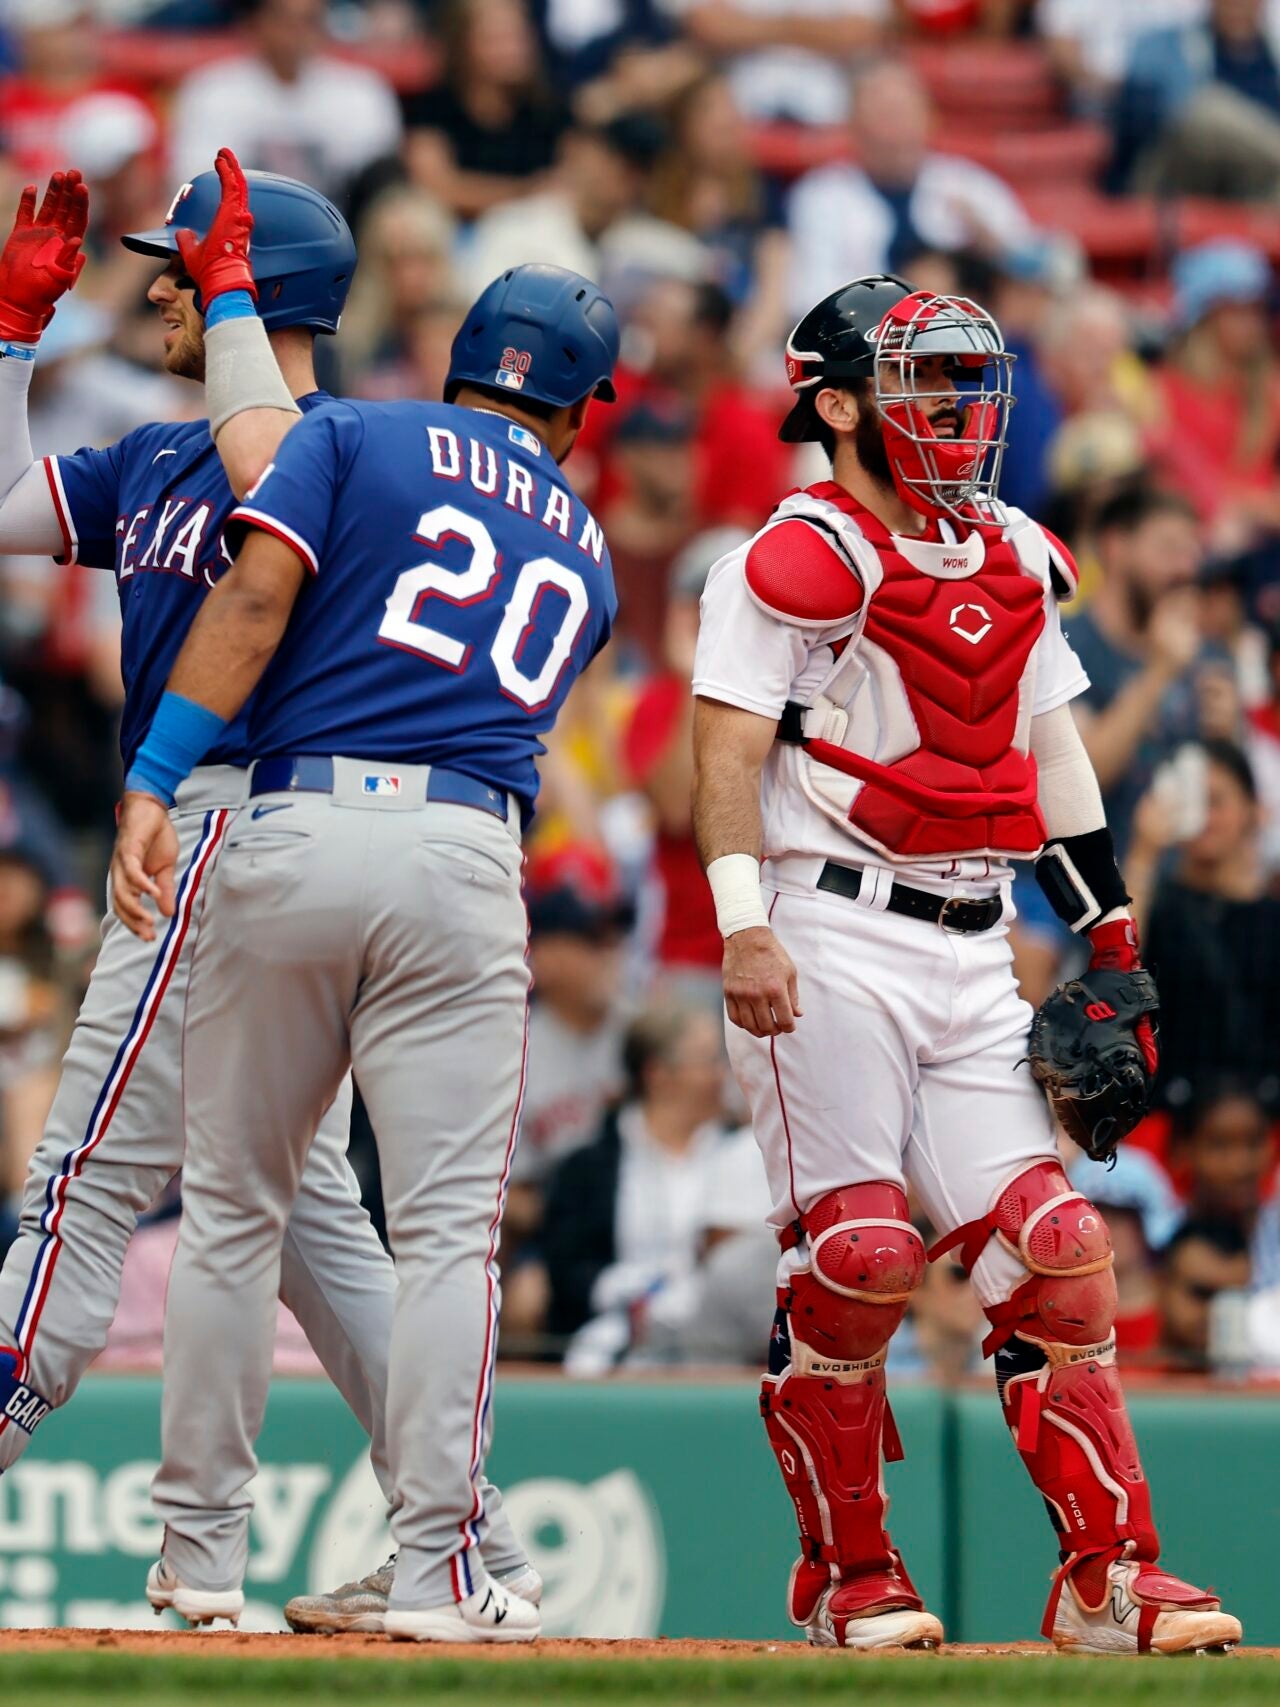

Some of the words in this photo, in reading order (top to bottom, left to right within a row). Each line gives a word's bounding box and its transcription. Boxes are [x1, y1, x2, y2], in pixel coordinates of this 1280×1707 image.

[499, 346, 533, 375] 20
[426, 425, 606, 566] DURAN
[115, 499, 234, 589] EXA
[942, 557, 969, 569] WONG
[376, 503, 591, 713] 20
